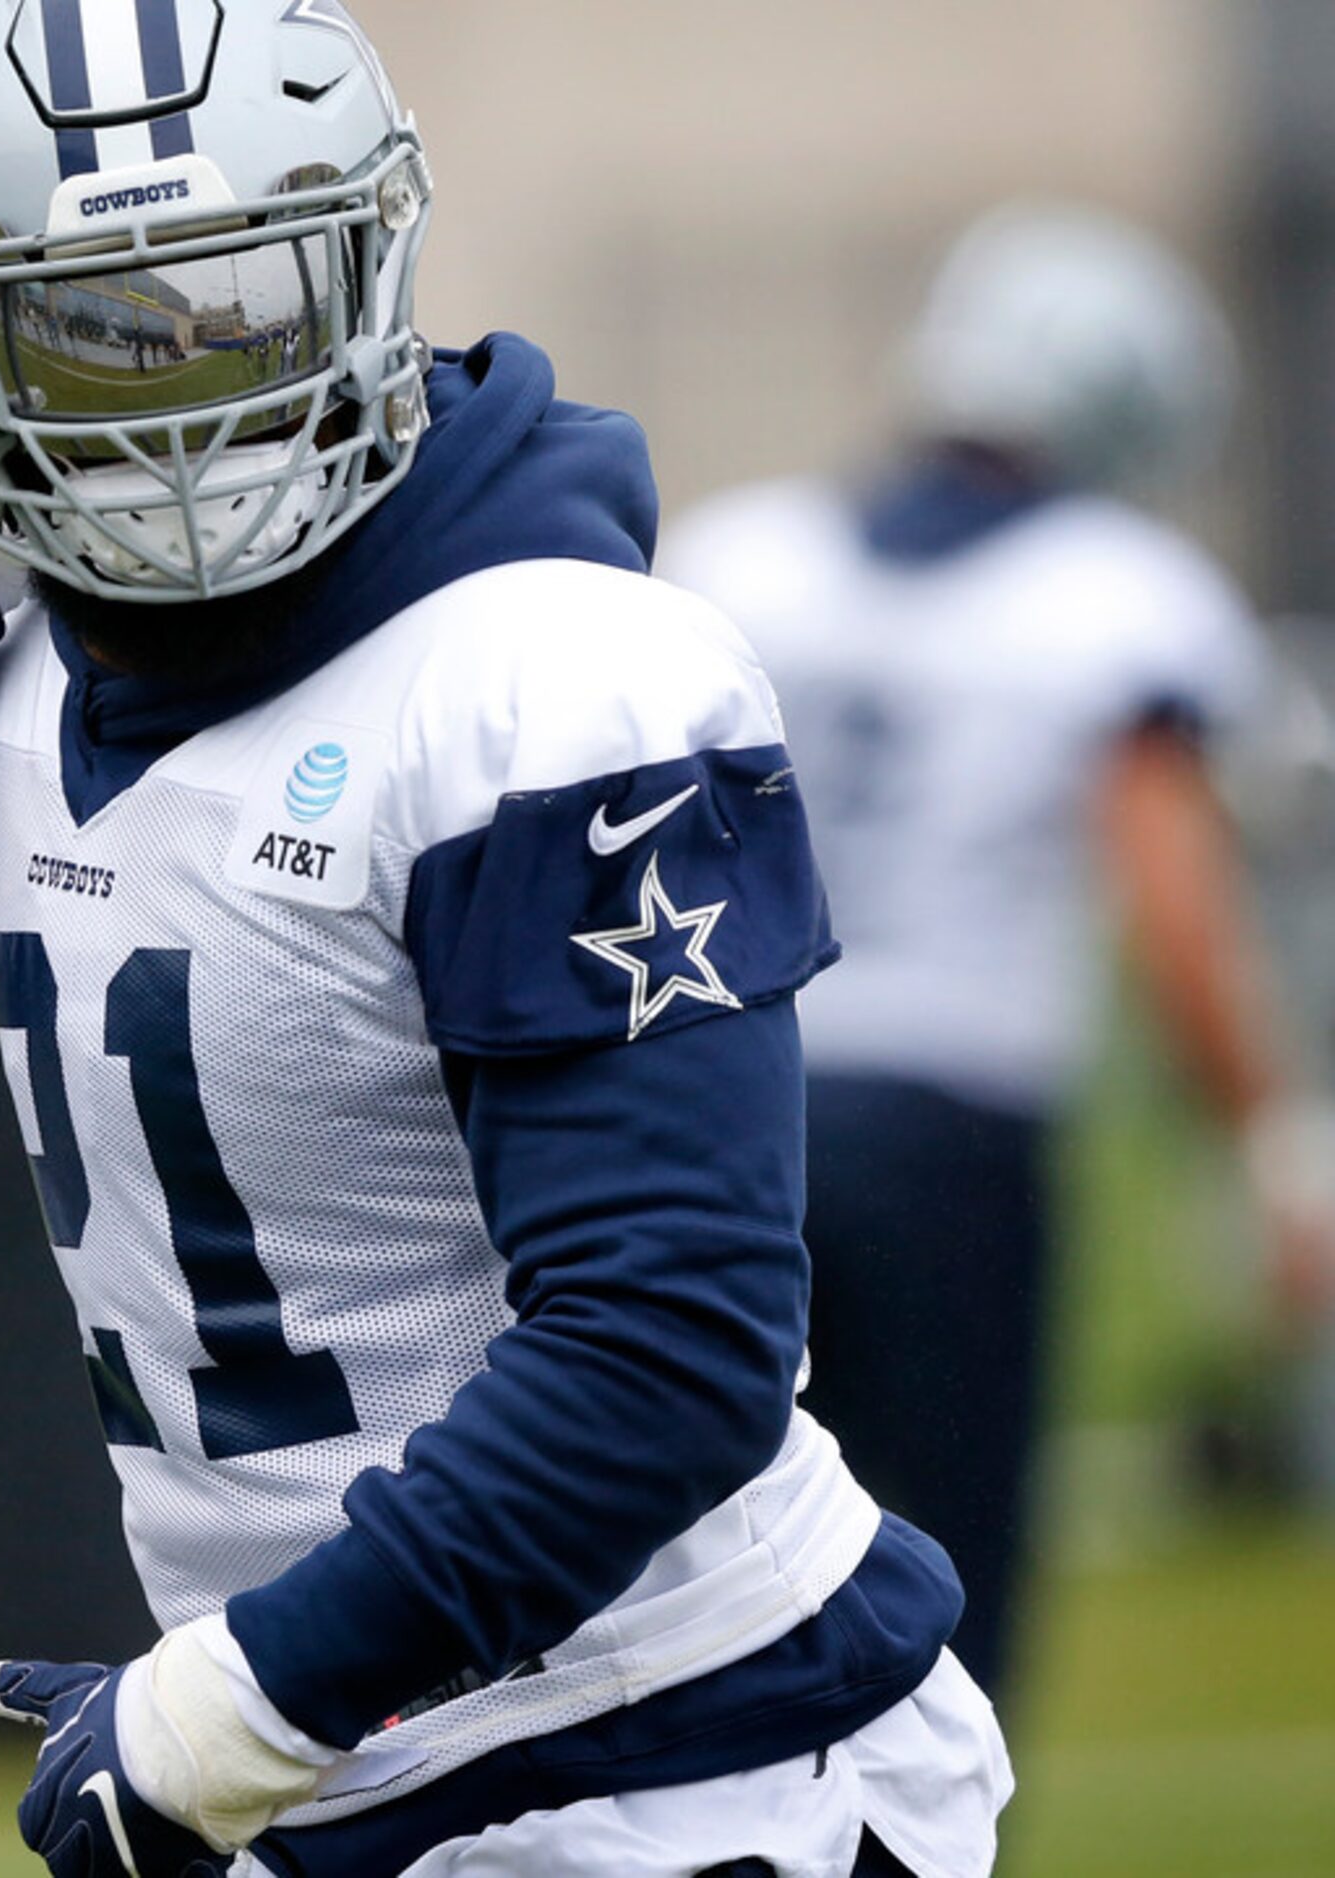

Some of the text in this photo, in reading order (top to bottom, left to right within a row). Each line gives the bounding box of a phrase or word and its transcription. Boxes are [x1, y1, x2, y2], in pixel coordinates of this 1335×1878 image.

[80, 179, 190, 217] COWBOYS
[27, 854, 115, 898] COWBOYS
[253, 832, 336, 880] AT&T
